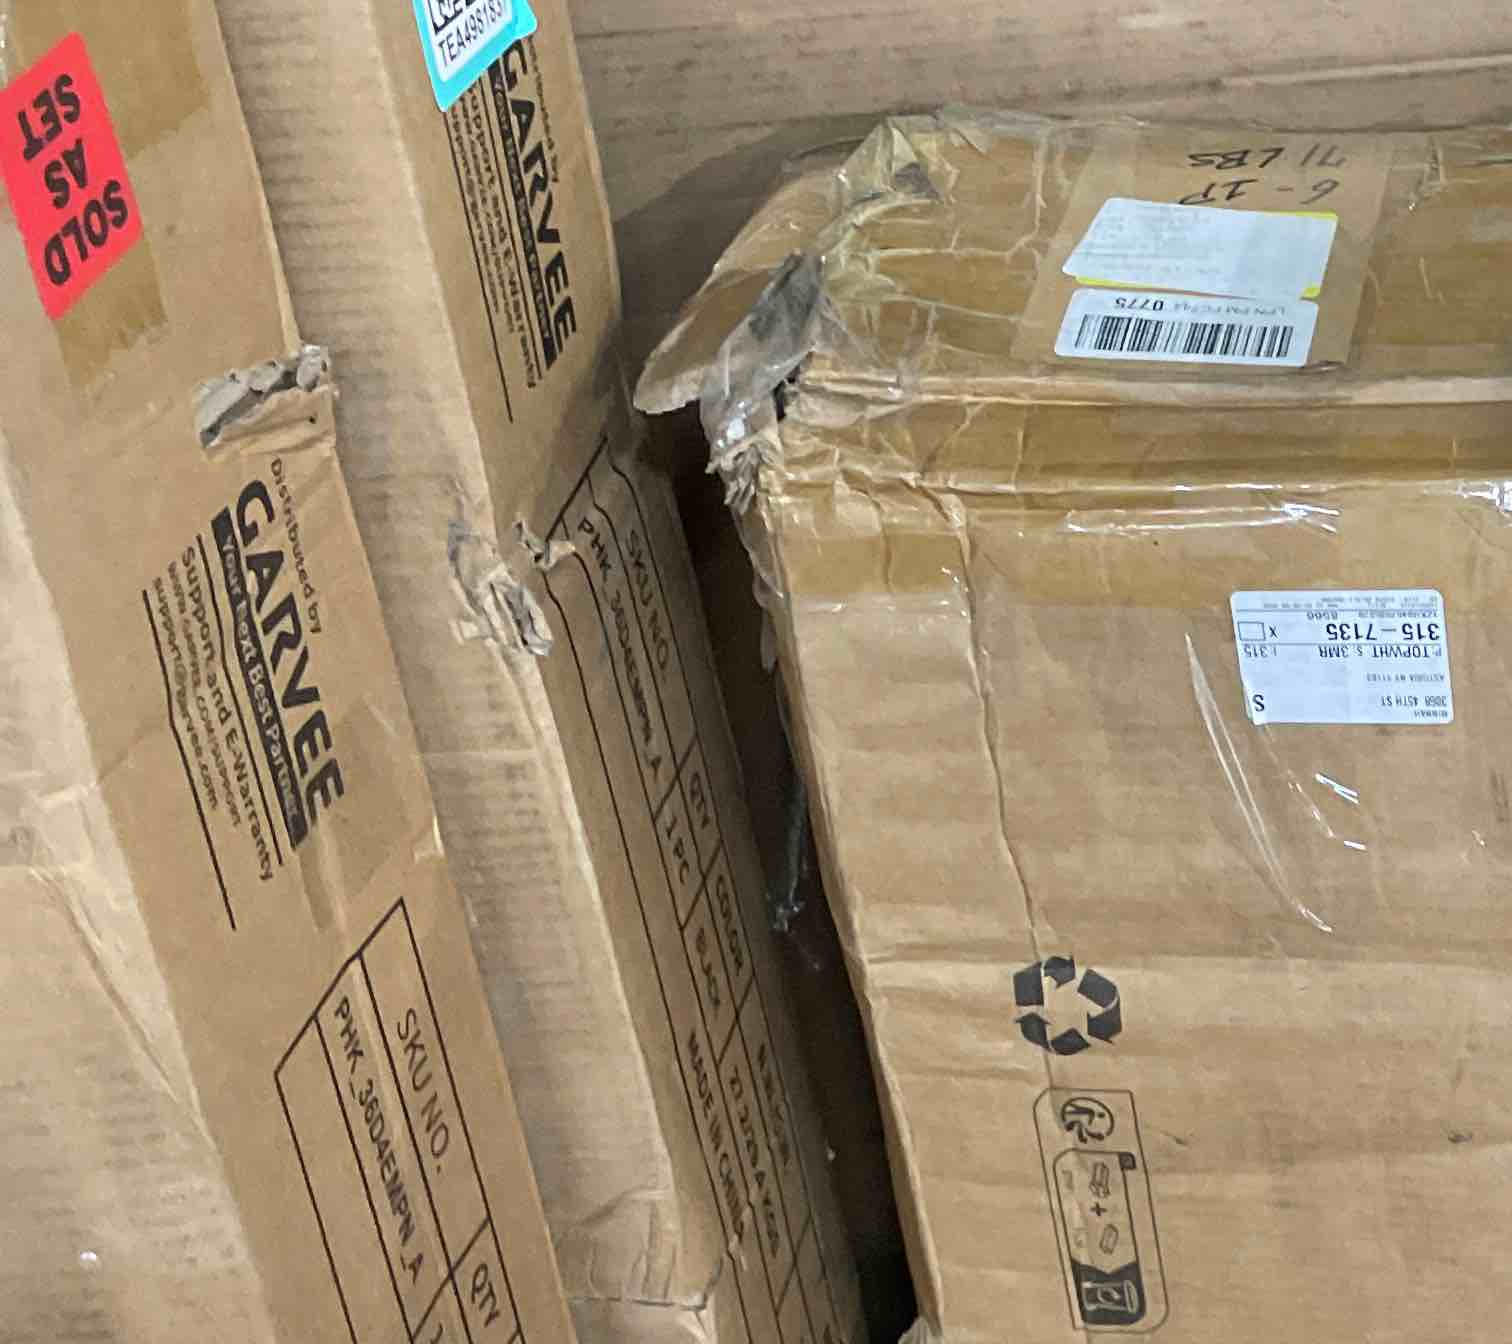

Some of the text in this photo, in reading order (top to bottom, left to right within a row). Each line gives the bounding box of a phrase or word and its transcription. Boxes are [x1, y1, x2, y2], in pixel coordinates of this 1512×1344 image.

[17, 73, 83, 161] SET
[1189, 146, 1283, 170] LBS
[44, 146, 86, 209] AS
[502, 41, 577, 354] GARVEE
[44, 178, 129, 286] SOLD
[1115, 297, 1164, 312] 0775
[268, 453, 326, 639] Distributed by
[215, 534, 245, 602] Your
[246, 660, 275, 727] Best
[235, 479, 346, 830] GARVEE
[1243, 645, 1269, 657] 315
[1326, 623, 1378, 640] 7135
[1401, 623, 1440, 641] 315
[176, 543, 276, 886] Support and E-Warranty
[1252, 694, 1265, 712] S
[669, 831, 691, 891] PC
[394, 1001, 453, 1179] SKU NO.
[467, 1256, 500, 1343] QTY
